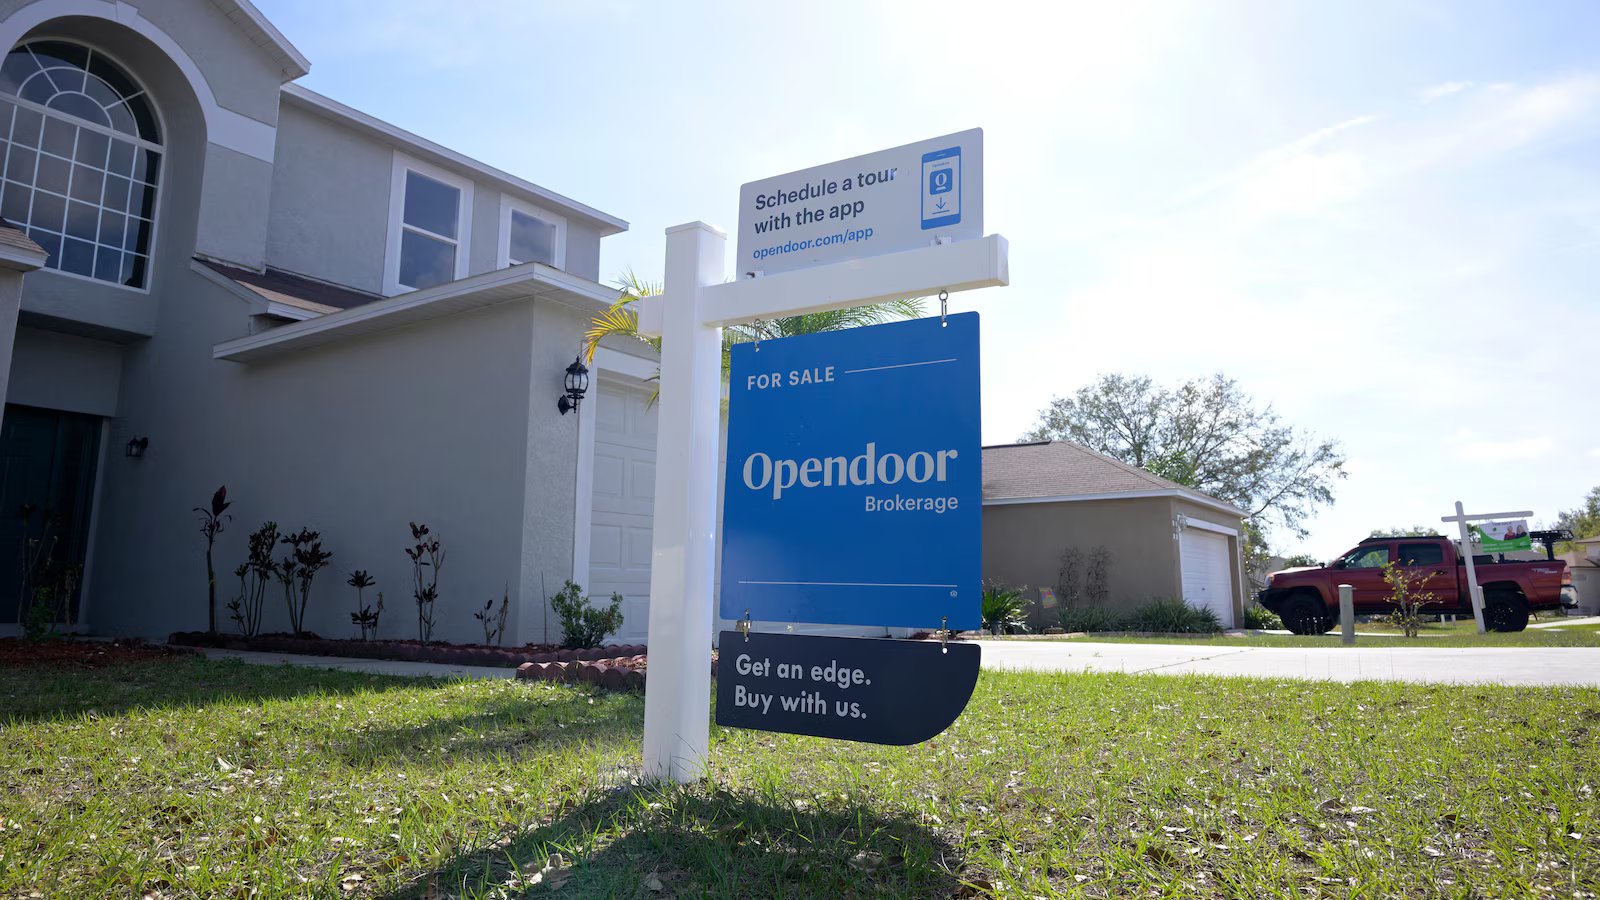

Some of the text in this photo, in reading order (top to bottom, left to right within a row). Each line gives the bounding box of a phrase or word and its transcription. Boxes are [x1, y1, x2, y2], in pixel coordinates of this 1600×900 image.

[755, 167, 898, 211] Schedule a tour
[754, 200, 865, 234] with the app
[753, 227, 874, 260] opendoor.com/app
[747, 366, 835, 390] FOR SALE
[743, 442, 958, 500] Opendoor
[865, 494, 958, 513] Brokerage
[735, 653, 872, 689] Get an edge.
[734, 684, 867, 719] Buy with us.
